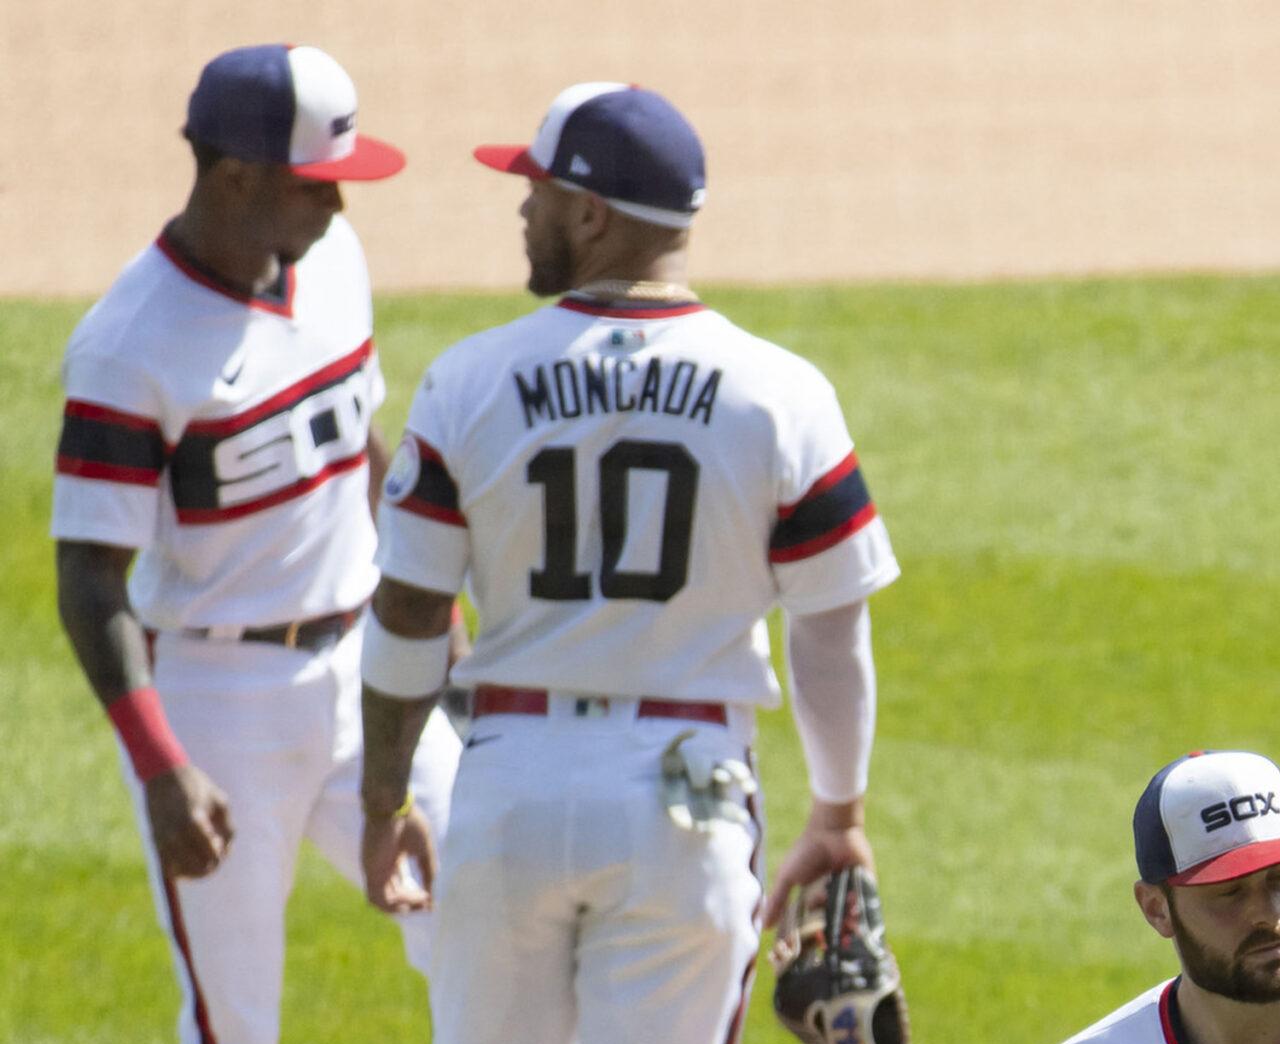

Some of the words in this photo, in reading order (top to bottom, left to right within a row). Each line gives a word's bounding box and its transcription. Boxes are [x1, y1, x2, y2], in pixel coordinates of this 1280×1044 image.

[514, 356, 723, 429] MONCADA
[526, 436, 700, 604] 10
[1199, 791, 1280, 833] SOX
